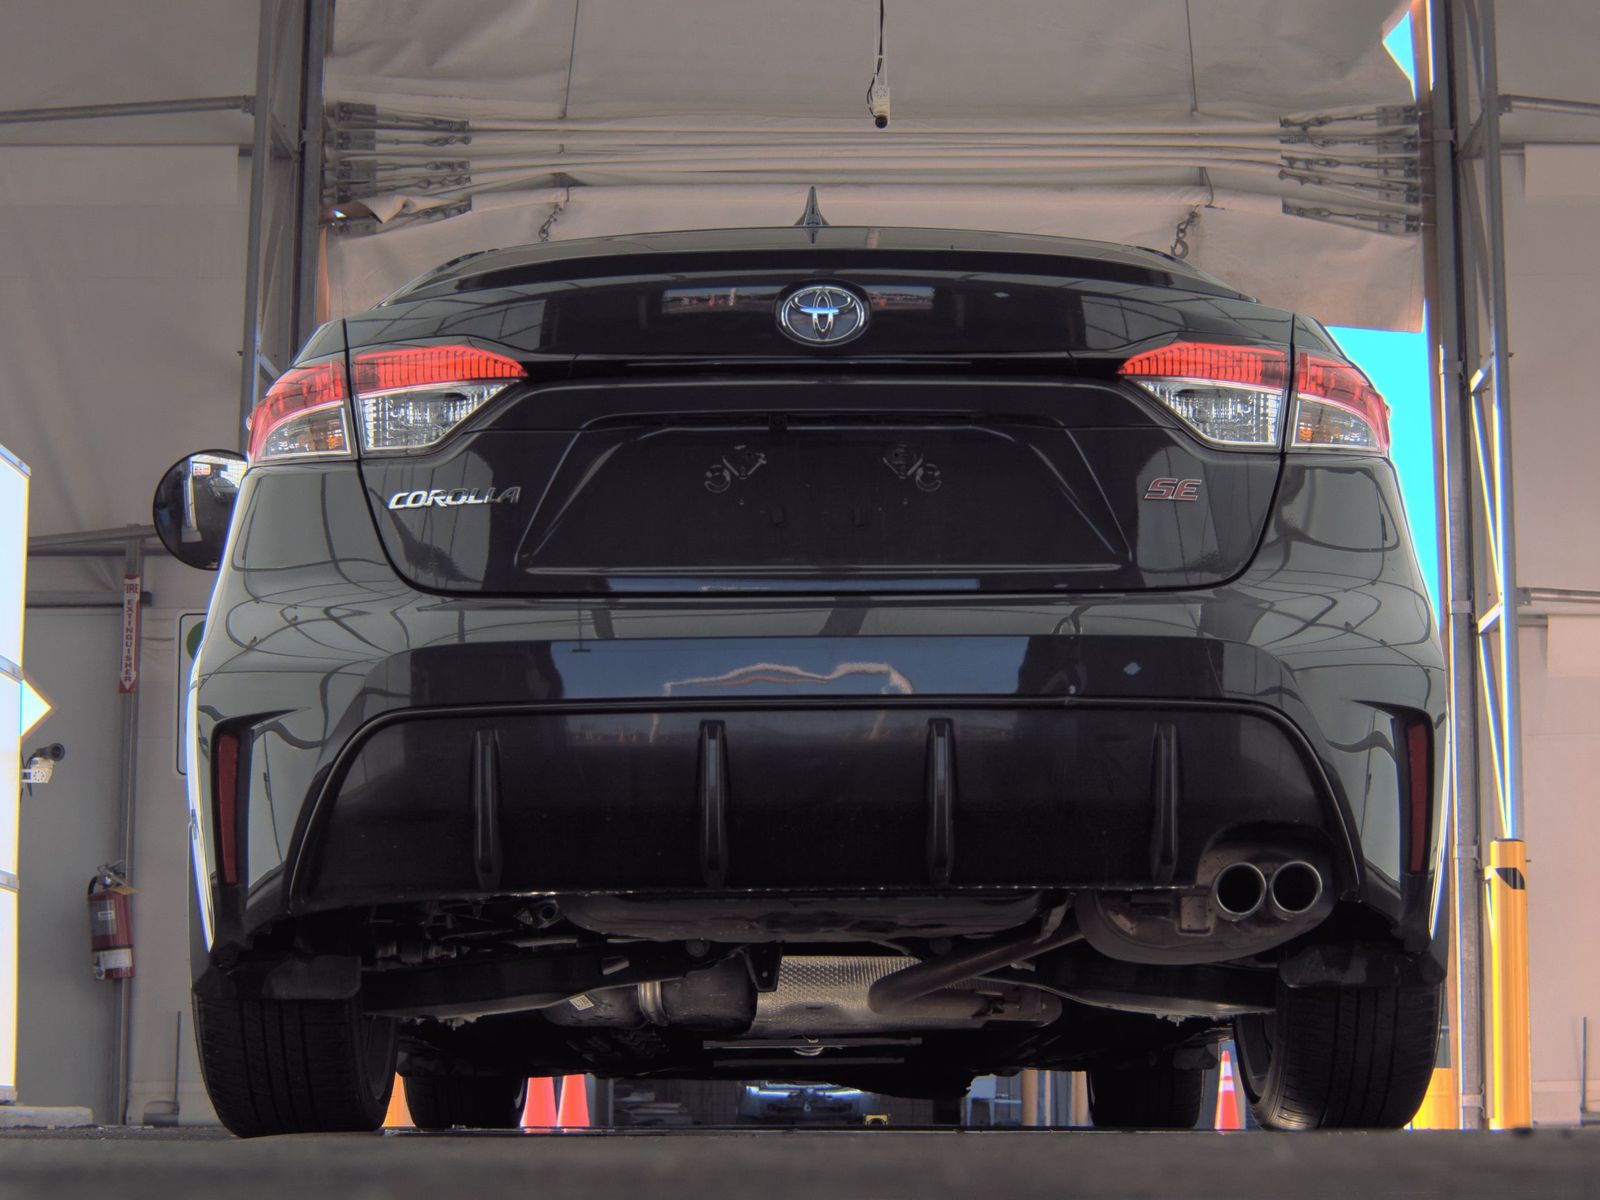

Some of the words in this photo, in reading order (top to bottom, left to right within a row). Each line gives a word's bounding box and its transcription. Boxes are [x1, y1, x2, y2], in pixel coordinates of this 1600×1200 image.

[388, 486, 521, 509] COROLLA
[1144, 477, 1202, 501] SE
[124, 599, 134, 682] EXTINGUISHER
